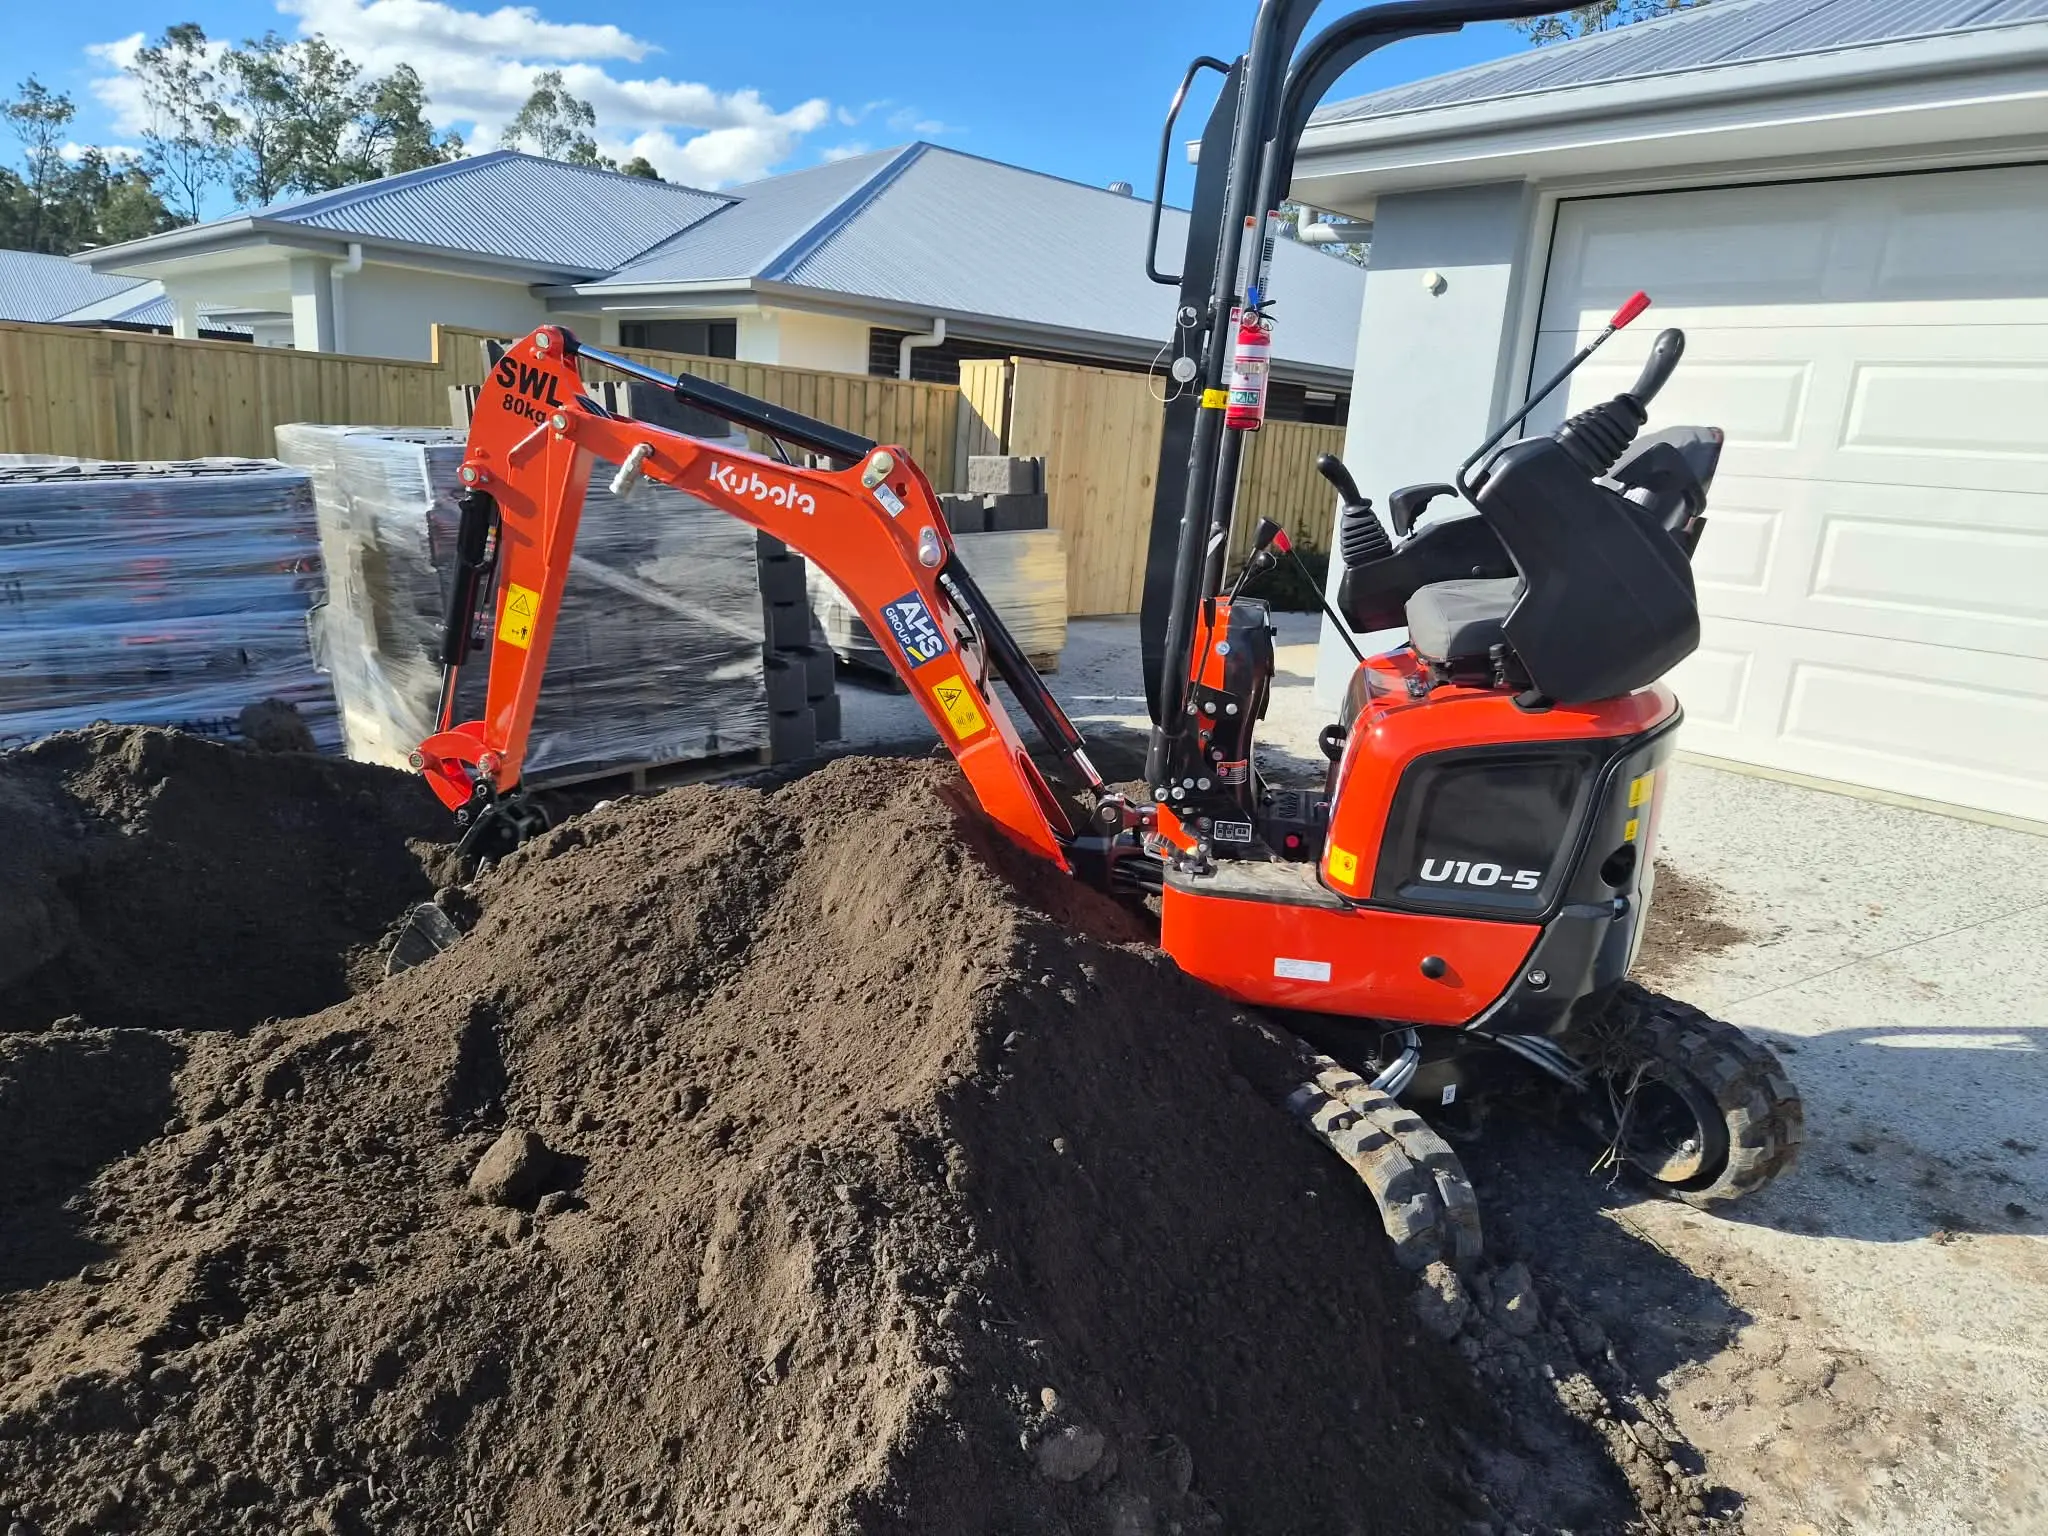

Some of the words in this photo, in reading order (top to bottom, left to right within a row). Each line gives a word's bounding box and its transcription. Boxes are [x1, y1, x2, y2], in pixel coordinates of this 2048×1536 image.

[496, 357, 563, 408] SWL
[502, 393, 546, 427] 80kg
[710, 462, 815, 515] Kubota
[885, 607, 912, 646] GROUP
[896, 602, 943, 658] AHS
[1420, 859, 1541, 890] U10-5
